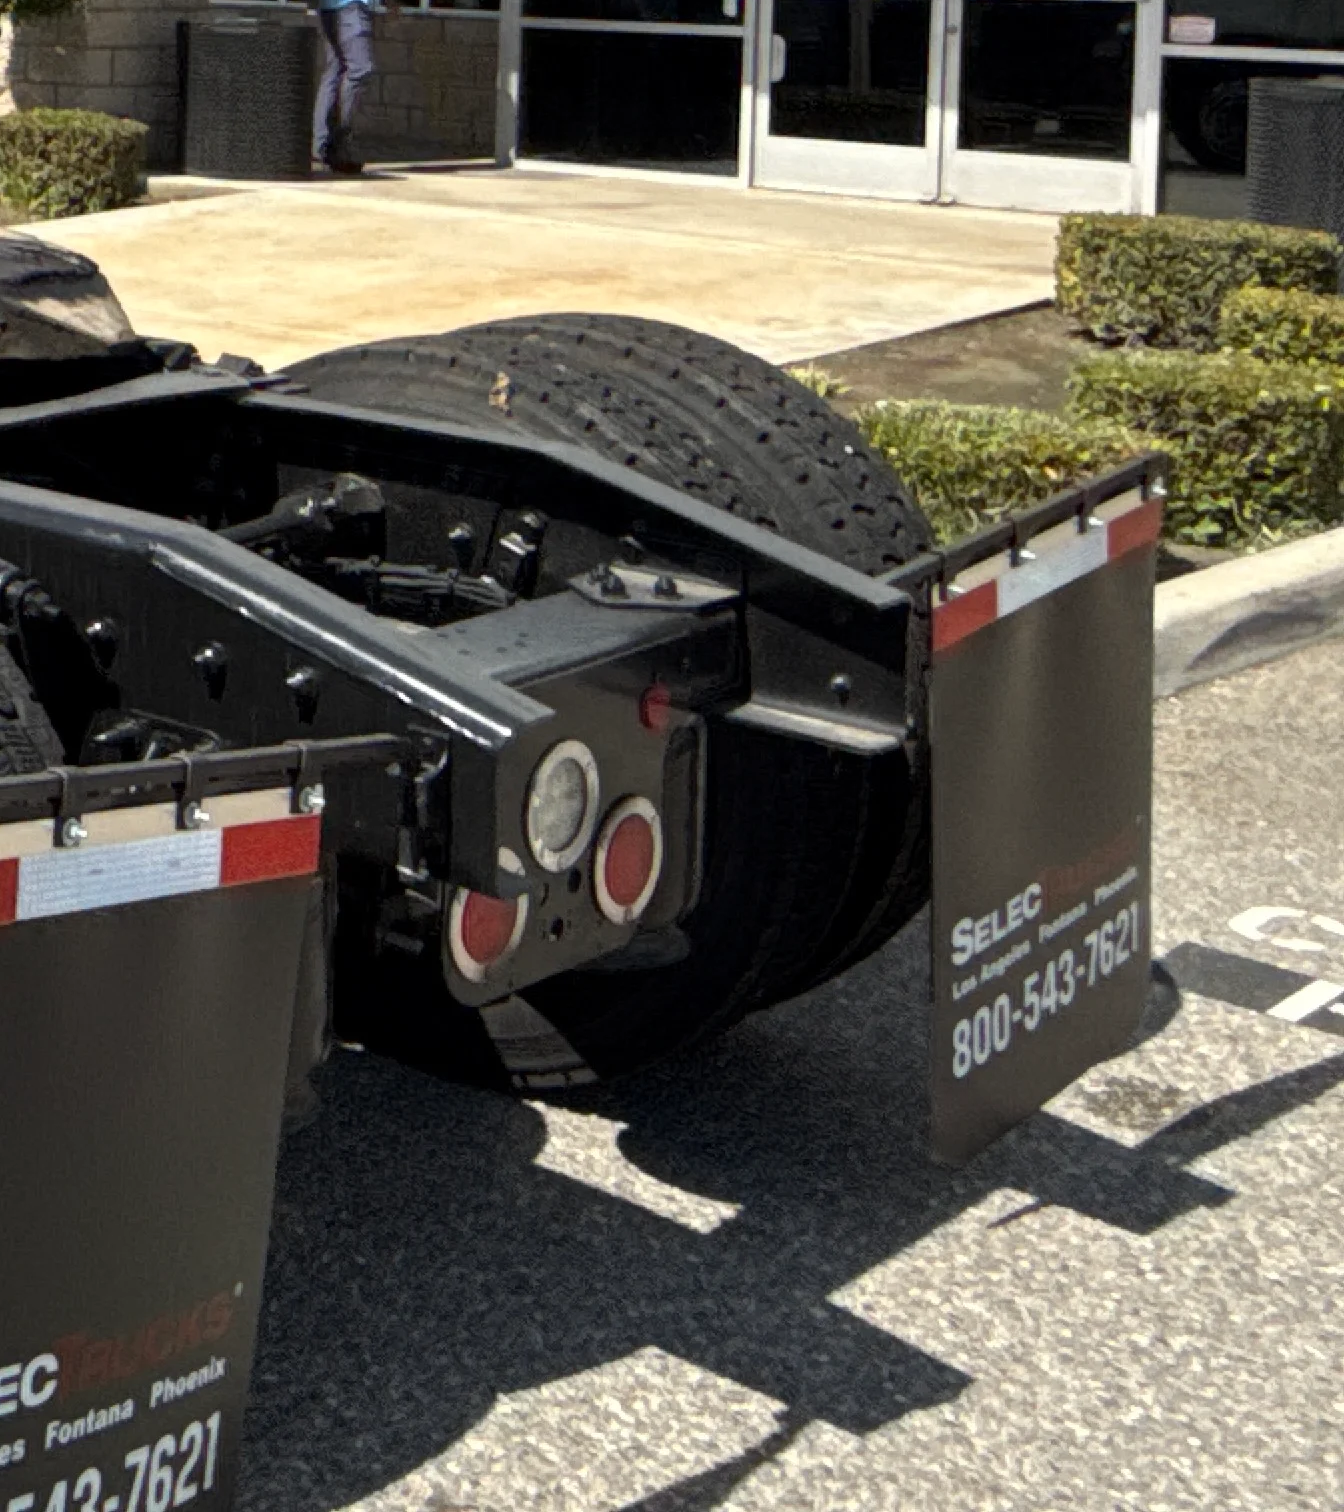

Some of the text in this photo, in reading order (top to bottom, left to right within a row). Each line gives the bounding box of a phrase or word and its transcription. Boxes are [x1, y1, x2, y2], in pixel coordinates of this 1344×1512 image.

[952, 900, 1140, 1079] 800-543-7621
[45, 1397, 135, 1451] Fontana
[149, 1355, 228, 1409] Phoenix
